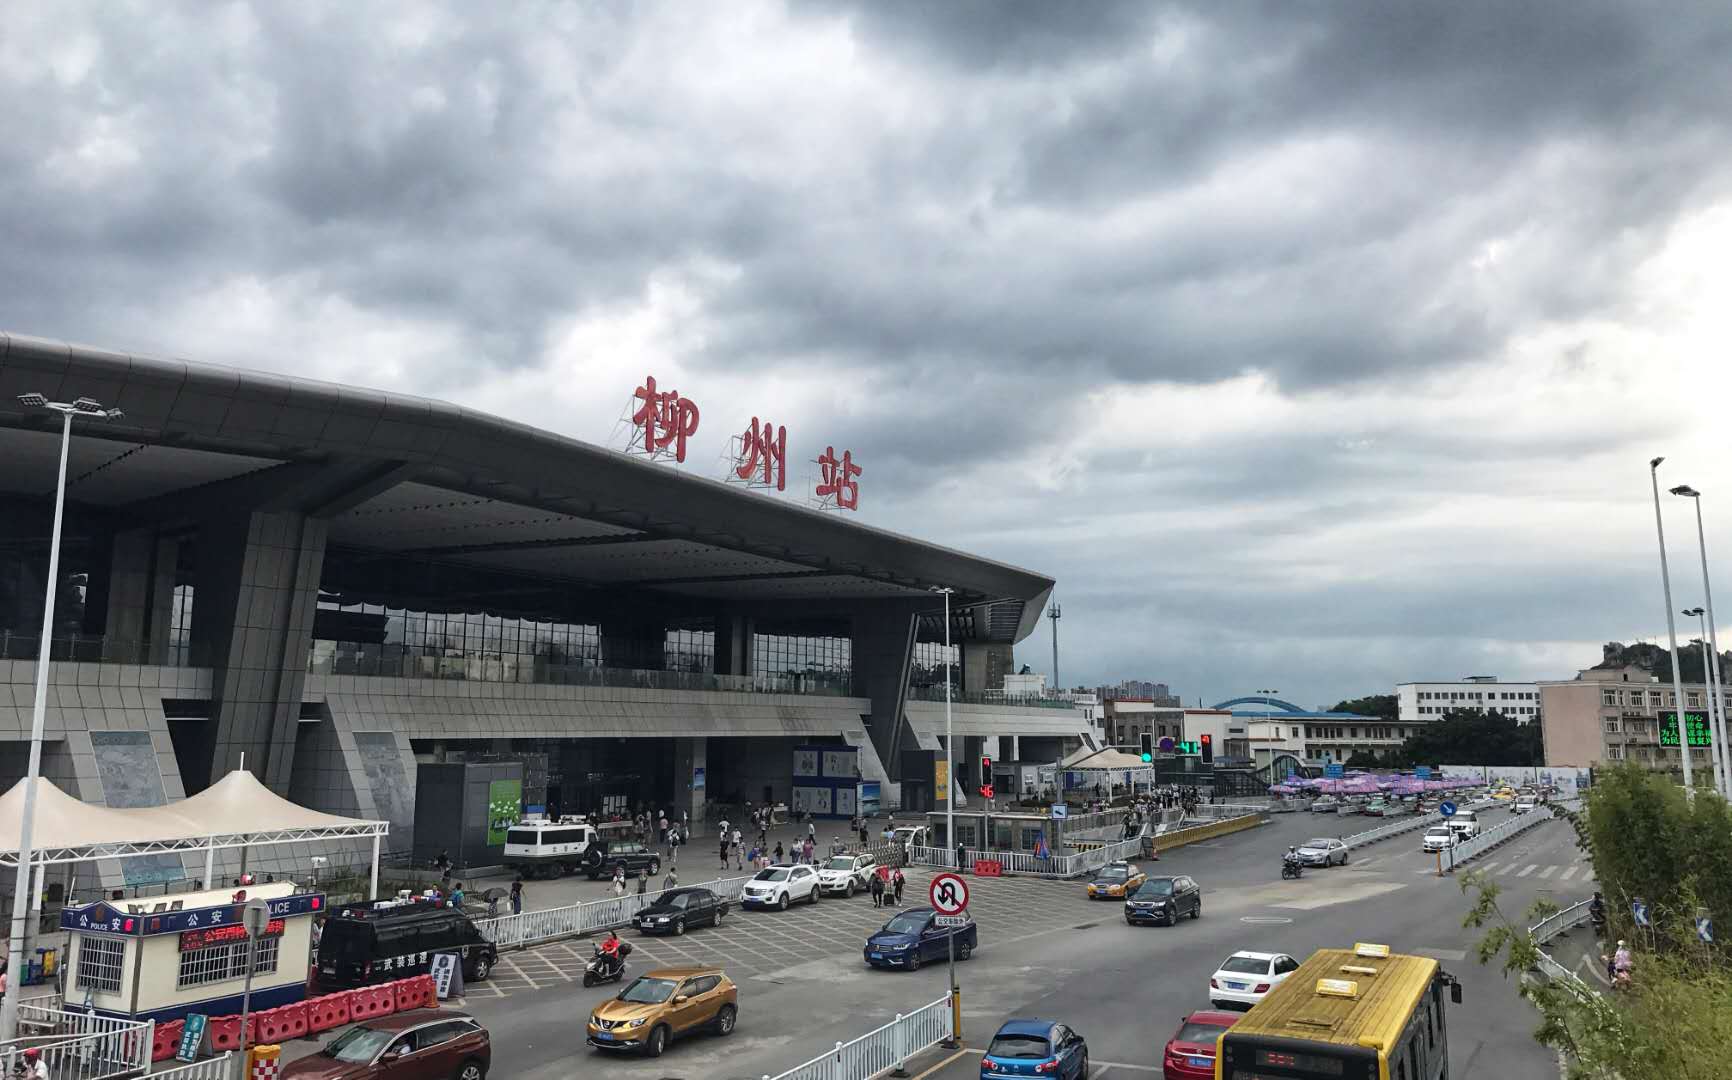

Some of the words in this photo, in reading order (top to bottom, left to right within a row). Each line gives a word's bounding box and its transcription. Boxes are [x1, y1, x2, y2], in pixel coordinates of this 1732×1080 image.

[633, 375, 862, 512] 柳州站
[1668, 714, 1703, 722] 不初心
[980, 784, 995, 798] 46
[187, 910, 222, 927] 公安
